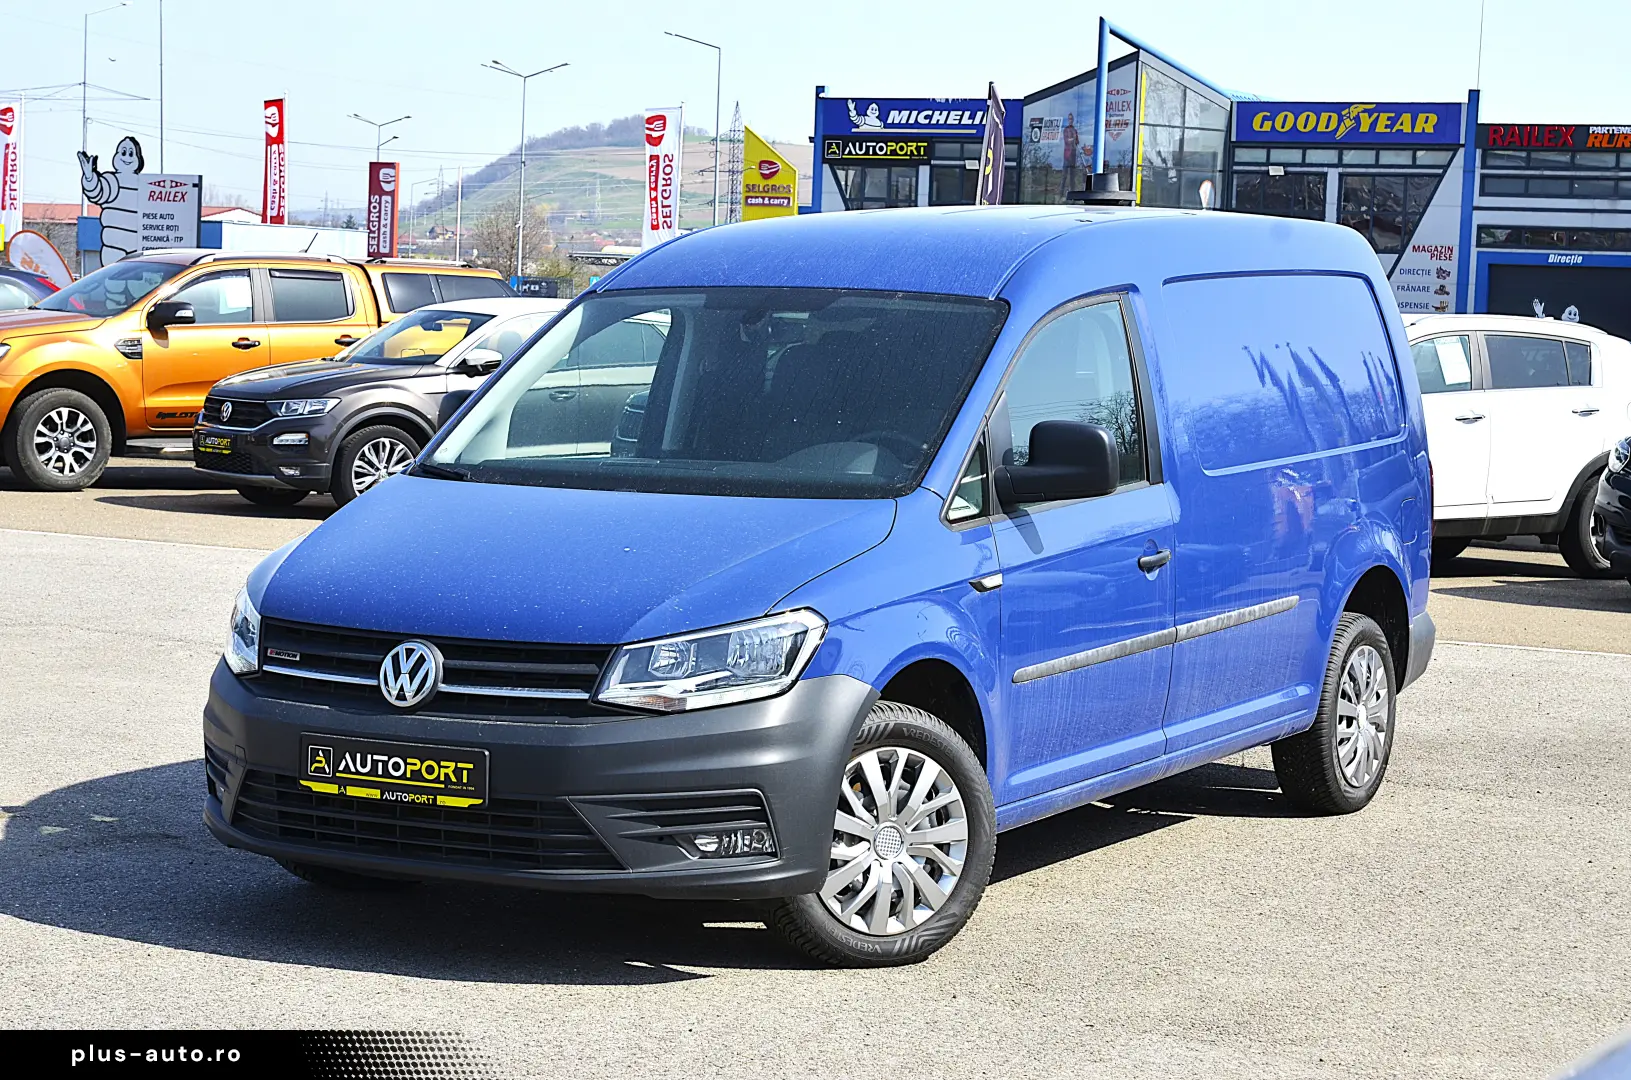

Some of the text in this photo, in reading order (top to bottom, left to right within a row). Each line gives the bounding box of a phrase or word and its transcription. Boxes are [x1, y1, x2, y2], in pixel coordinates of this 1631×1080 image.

[887, 110, 987, 125] MICHELI
[1488, 126, 1575, 147] RAILEX
[844, 142, 927, 155] AUTOPORT
[745, 184, 791, 194] SELGROS
[148, 190, 188, 203] RAILEX
[142, 212, 158, 220] PIESE
[142, 223, 164, 231] SERVICE
[369, 194, 379, 253] SELGROS
[1412, 245, 1454, 254] MAGAZIN
[1430, 252, 1453, 261] PIESE
[205, 437, 231, 446] AUTOPORT
[338, 752, 474, 783] AUTOPORT
[383, 791, 434, 804] AUTOPORT
